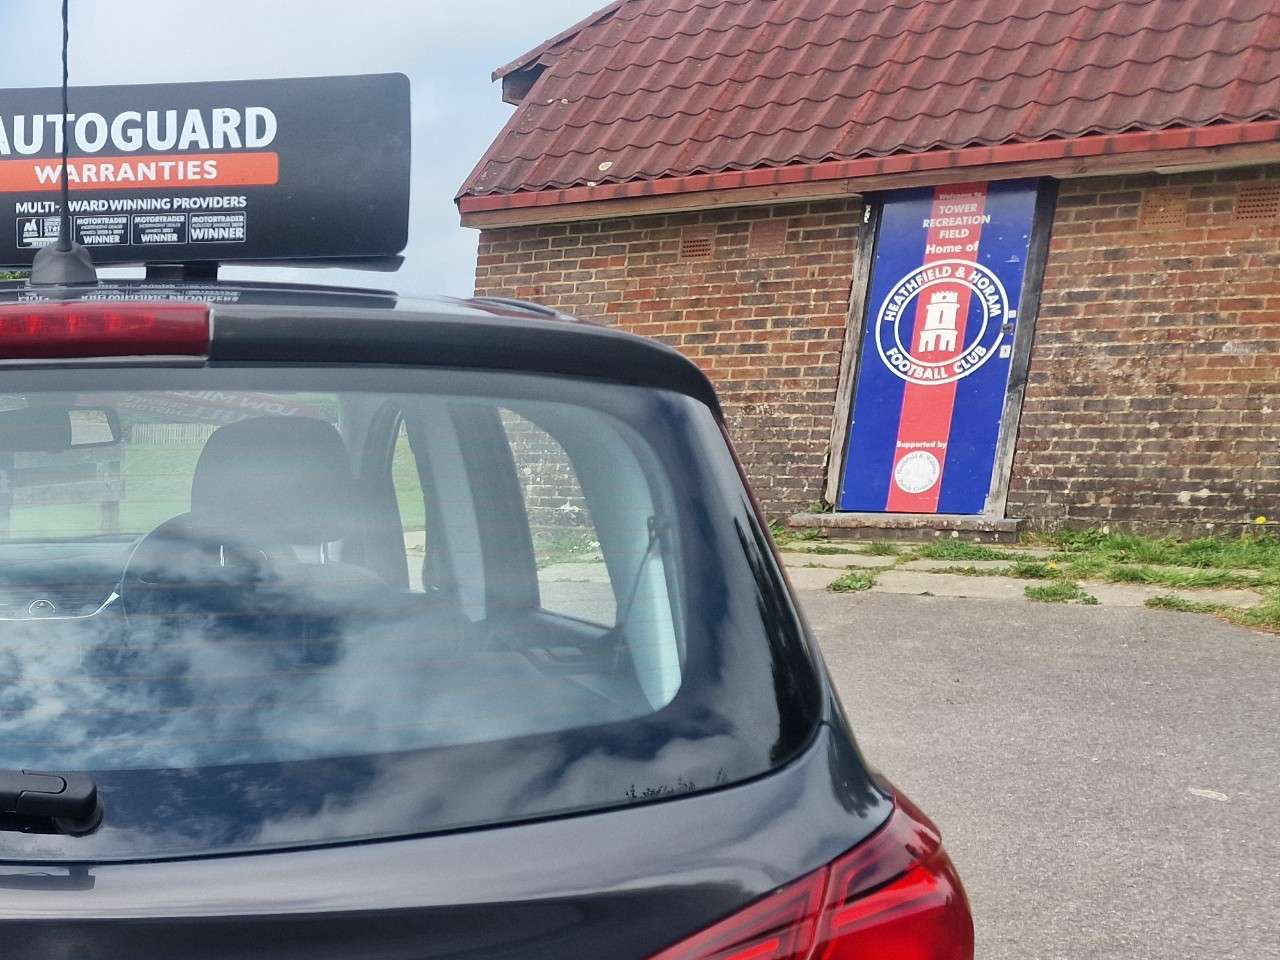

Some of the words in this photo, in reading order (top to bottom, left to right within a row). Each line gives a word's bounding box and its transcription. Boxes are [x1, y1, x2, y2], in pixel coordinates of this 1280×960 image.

[34, 160, 218, 185] WARRANTIES
[15, 199, 109, 214] MULTI-WARD
[109, 198, 171, 212] WINNING
[173, 196, 247, 209] PROVIDERS
[939, 203, 978, 215] TOWER
[922, 214, 991, 228] RECREATION
[82, 234, 121, 244] WINNER
[140, 233, 178, 242] WINNER
[191, 227, 244, 240] WINNER
[939, 228, 970, 239] FIELD
[925, 243, 962, 254] Home
[965, 241, 980, 252] of
[884, 265, 952, 321] HEATHFIELD
[955, 266, 966, 278] &
[967, 270, 1002, 318] HORAM
[886, 347, 948, 380] FOOTBALL
[952, 345, 987, 373] CLUB
